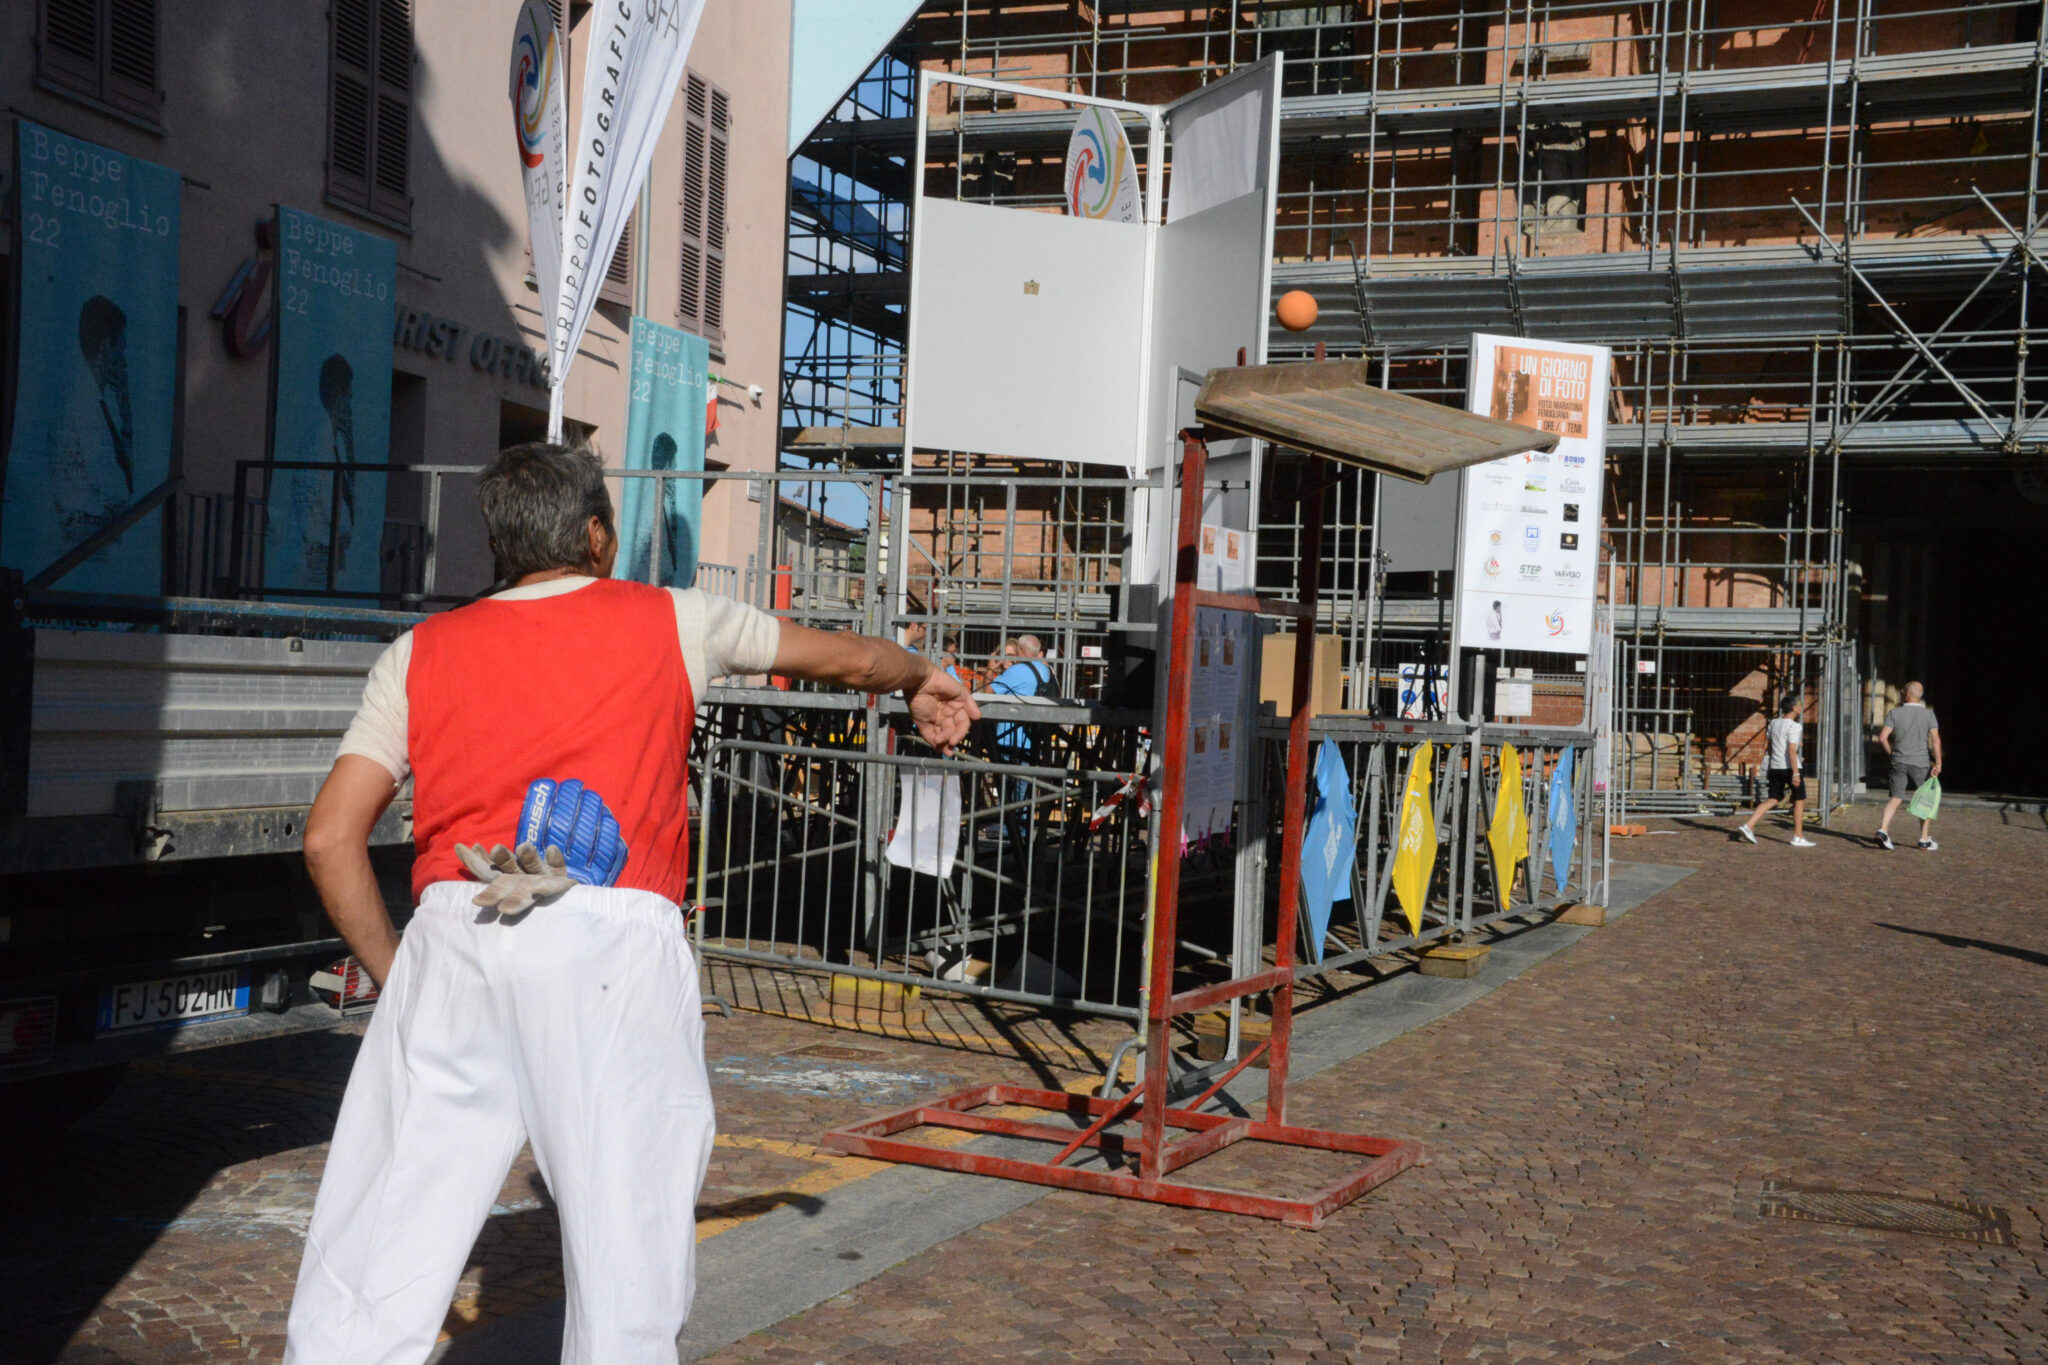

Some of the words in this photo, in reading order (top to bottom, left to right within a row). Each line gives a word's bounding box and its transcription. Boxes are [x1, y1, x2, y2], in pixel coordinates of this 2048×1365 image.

[30, 129, 122, 183] Beppe
[30, 170, 170, 237] Fenoglio
[29, 212, 61, 248] 22
[287, 213, 354, 257] Beppe
[287, 248, 387, 301] Fenoglio
[286, 285, 308, 315] 22
[637, 322, 681, 355] Beppe
[471, 331, 552, 389] OFFIC
[635, 350, 703, 389] Fenoglio
[1520, 355, 1538, 376] UN
[1541, 357, 1588, 381] GIORNO
[632, 379, 651, 403] 22
[1538, 399, 1553, 409] FOTO
[1539, 377, 1552, 397] DI
[1555, 379, 1586, 400] FOTO
[1543, 421, 1555, 432] ORE
[1568, 423, 1582, 434] TEMI
[1520, 564, 1542, 575] STEP
[526, 783, 550, 843] eusch
